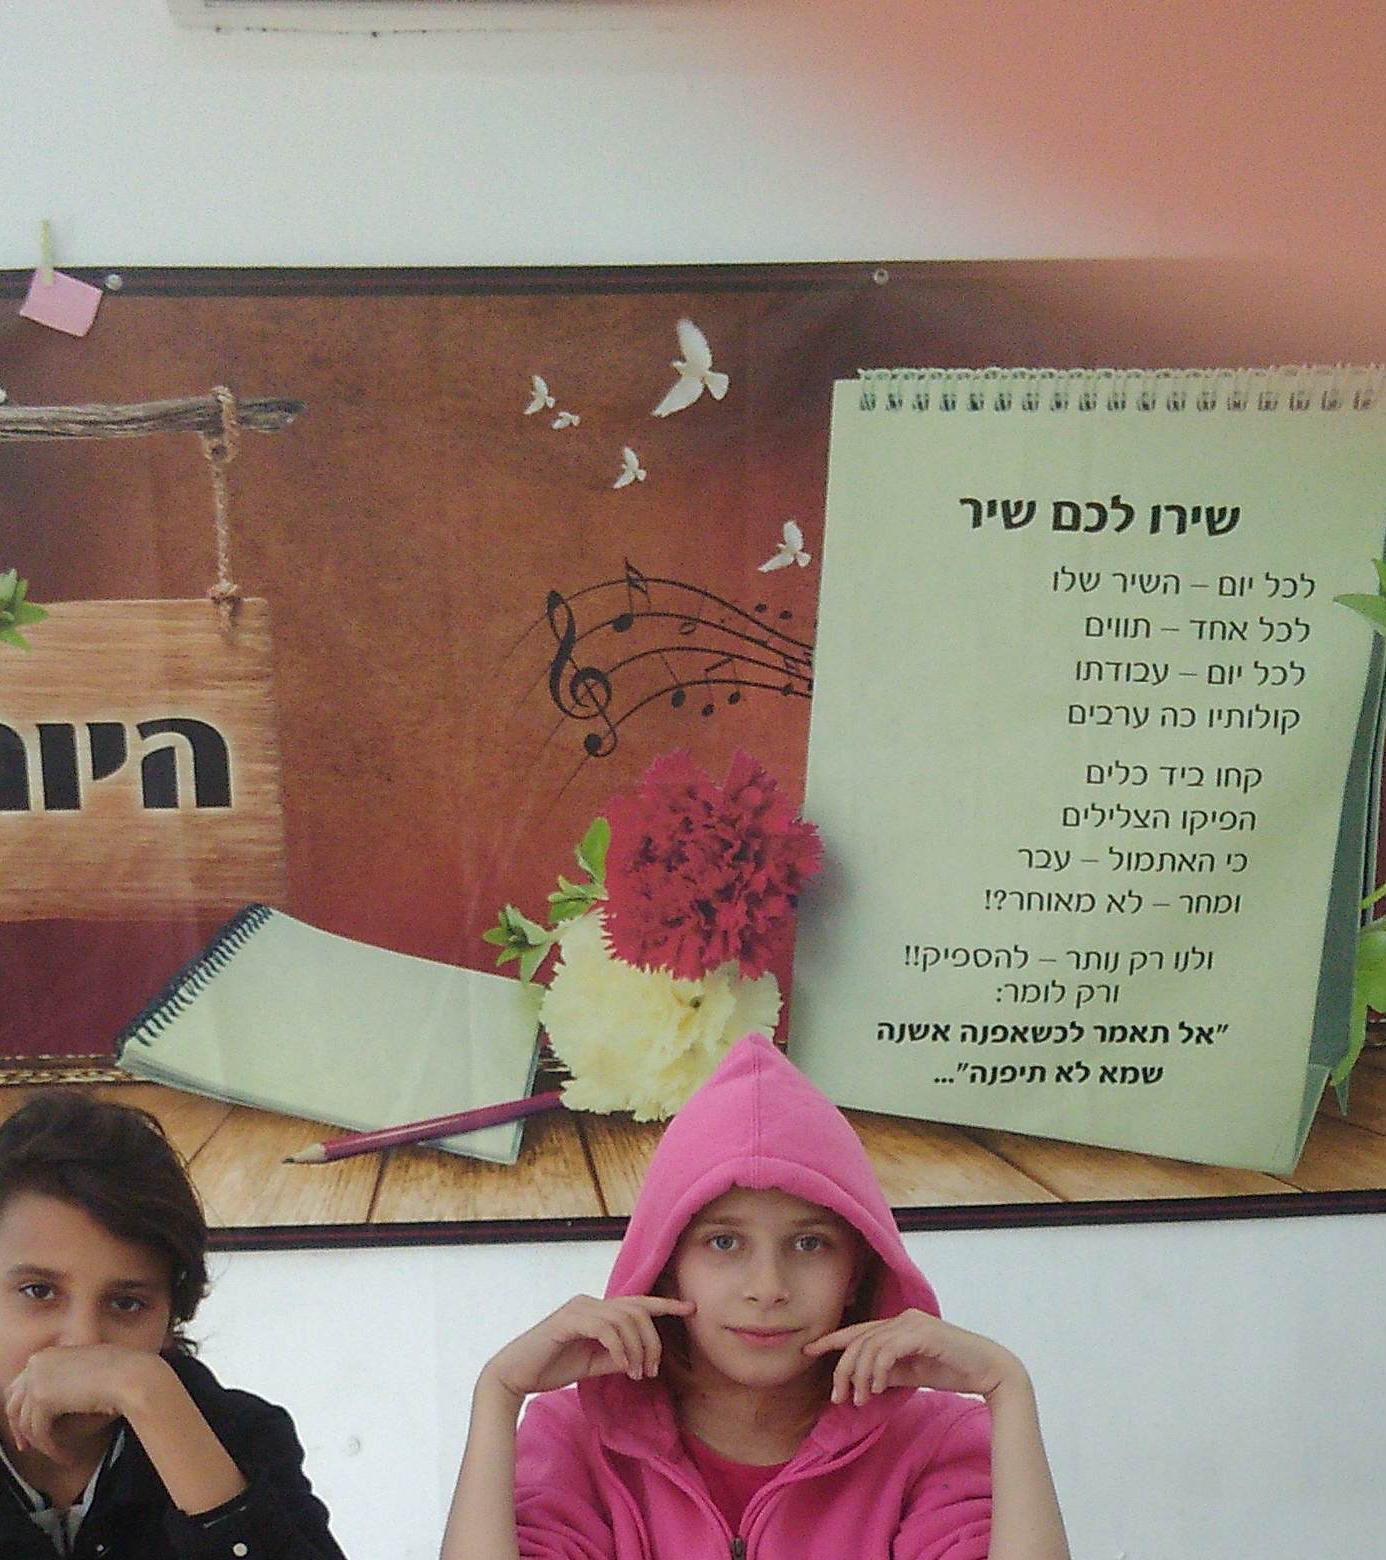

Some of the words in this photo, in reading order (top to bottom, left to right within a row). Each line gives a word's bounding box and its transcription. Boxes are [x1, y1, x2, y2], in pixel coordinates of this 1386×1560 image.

[959, 497, 1037, 530] שיר
[1052, 494, 1135, 533] לכם
[1149, 504, 1241, 537] שירו
[1053, 565, 1101, 593] שלו
[1112, 572, 1180, 595] השיר
[1218, 575, 1254, 597] יום
[1265, 571, 1316, 599] לכל
[1085, 616, 1151, 639] תווים
[1189, 619, 1249, 641] אחד
[1259, 617, 1310, 643] לכל
[1075, 660, 1169, 686] עבודתו
[1207, 664, 1243, 685] יום
[1253, 660, 1306, 687] לכל
[1068, 704, 1150, 729] ערבים
[1160, 706, 1196, 728] כה
[1208, 703, 1301, 736] קולותיו
[1086, 760, 1148, 786] כלים
[1159, 766, 1204, 787] ביד
[1216, 767, 1263, 795] קחו
[1062, 802, 1170, 829] הצלילים
[1181, 810, 1256, 836] הפיקו
[1017, 848, 1071, 873] עבר
[1108, 846, 1215, 873] האתמול
[1226, 853, 1248, 873] כי
[1106, 889, 1143, 914] לא
[1179, 894, 1241, 914] ומחר
[1066, 950, 1120, 974] נותר
[1129, 951, 1164, 976] רק
[1174, 945, 1214, 973] ולנו
[996, 979, 1066, 1004] לומר:
[1075, 984, 1120, 1010] ורק
[877, 1022, 951, 1044] אשנה
[960, 1020, 1085, 1046] לכשאפנה
[1092, 1024, 1170, 1044] תאמר
[1055, 1060, 1091, 1084] לא
[1099, 1065, 1164, 1085] שמא
